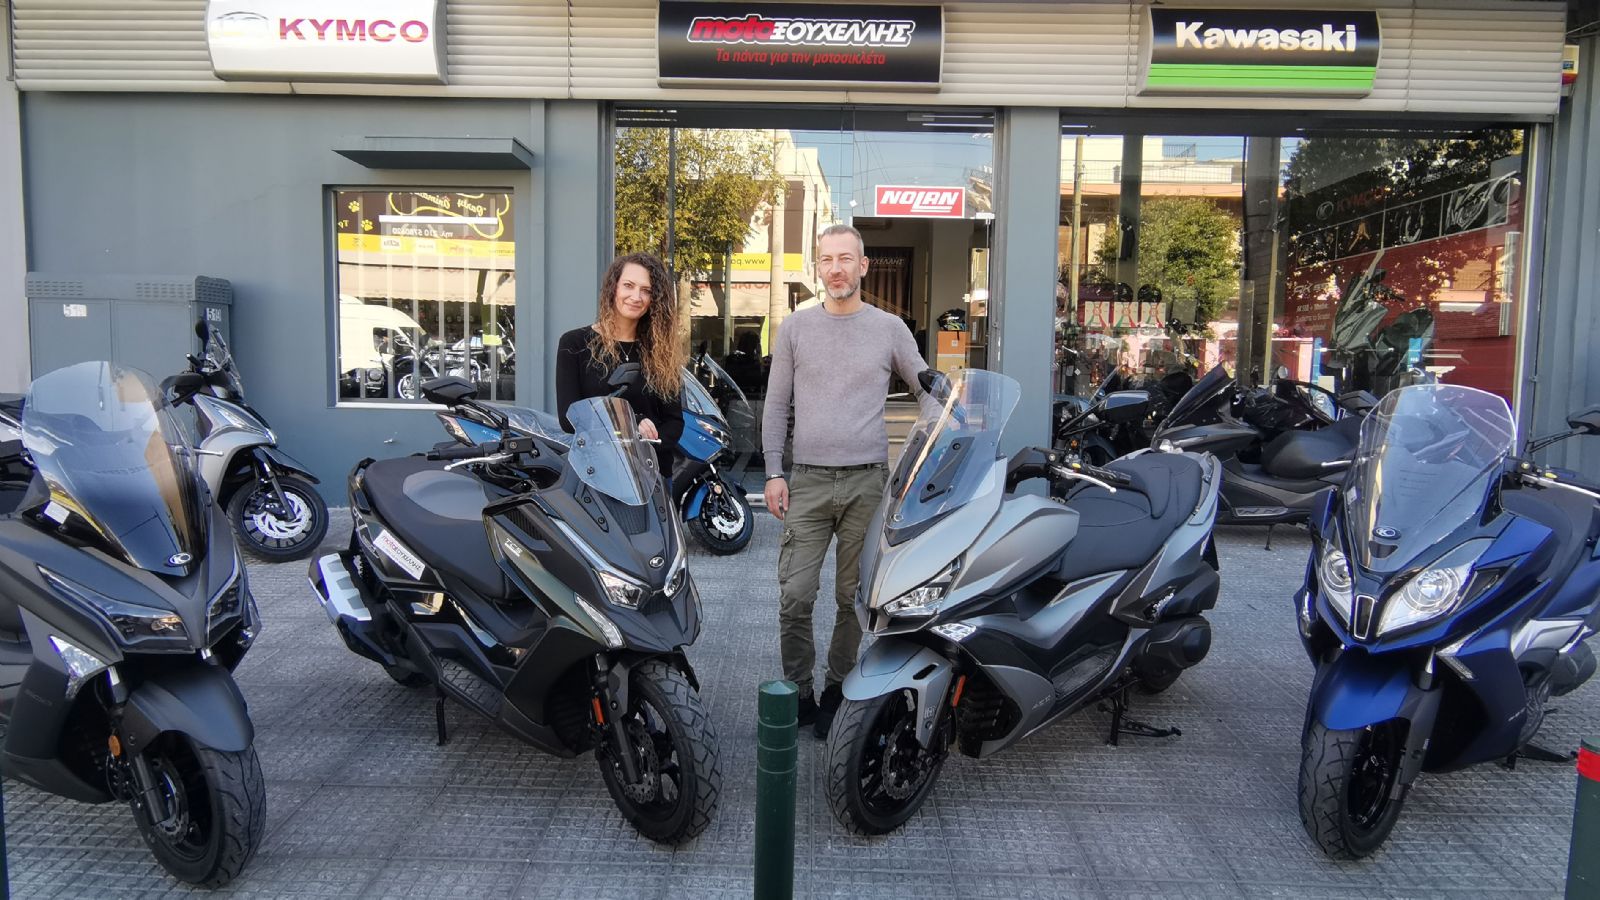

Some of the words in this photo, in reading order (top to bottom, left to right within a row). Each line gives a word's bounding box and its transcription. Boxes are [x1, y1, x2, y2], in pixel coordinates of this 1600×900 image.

[279, 18, 429, 43] KYMCO
[1175, 21, 1357, 52] Kawasaki
[716, 48, 730, 62] Τα
[733, 49, 767, 63] πάντα
[770, 51, 788, 66] για
[791, 51, 810, 65] την
[879, 190, 960, 211] NOLAN
